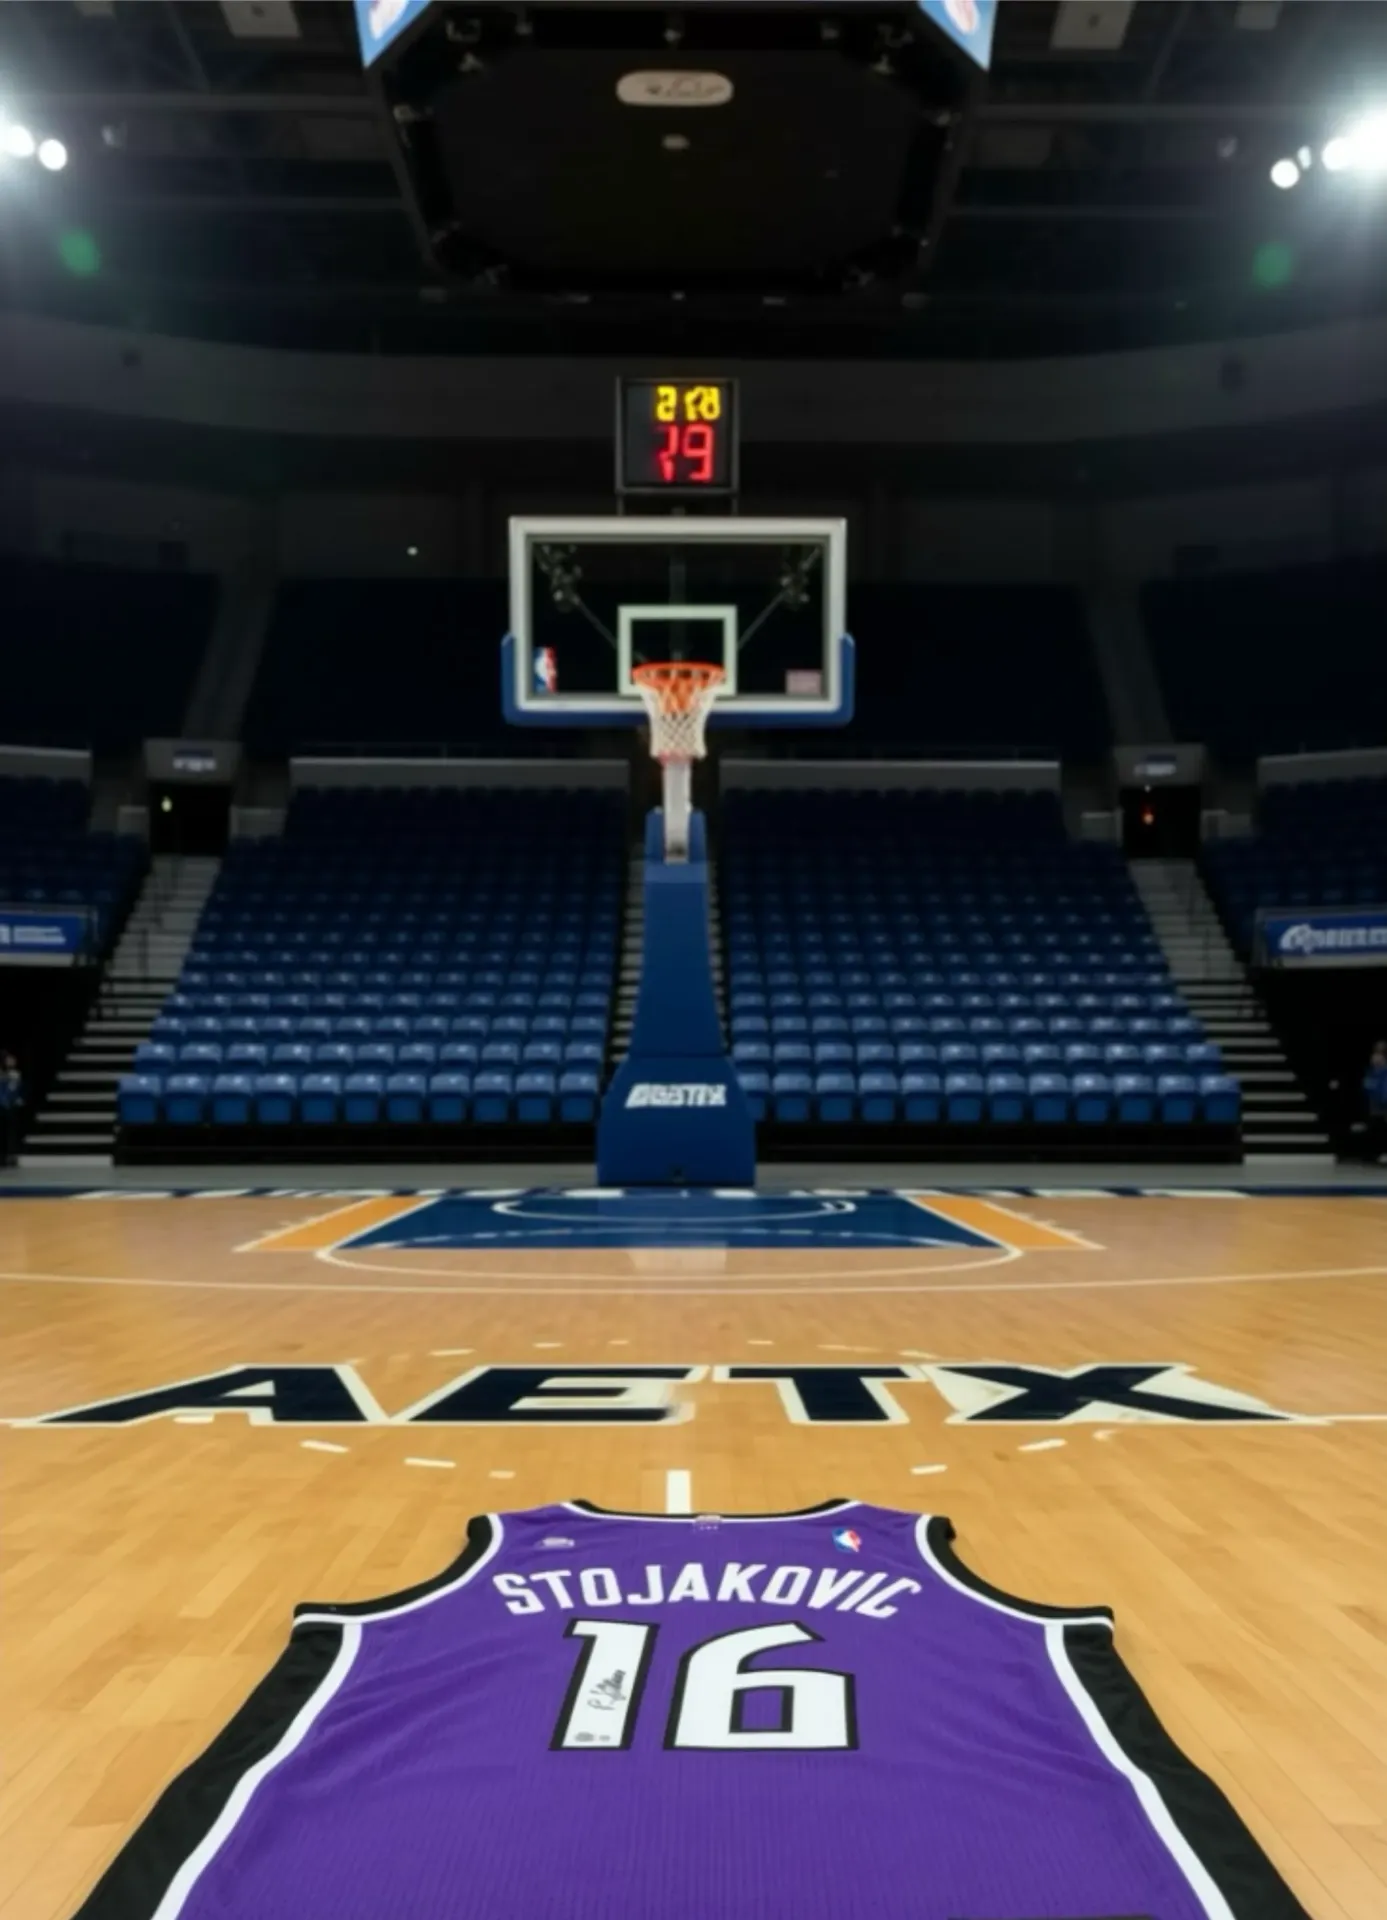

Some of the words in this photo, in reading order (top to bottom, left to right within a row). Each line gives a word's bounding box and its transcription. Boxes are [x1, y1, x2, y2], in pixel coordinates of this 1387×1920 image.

[40, 1365, 1295, 1423] AETX
[493, 1562, 922, 1619] STOJAKOVIC
[549, 1618, 859, 1750] 16
